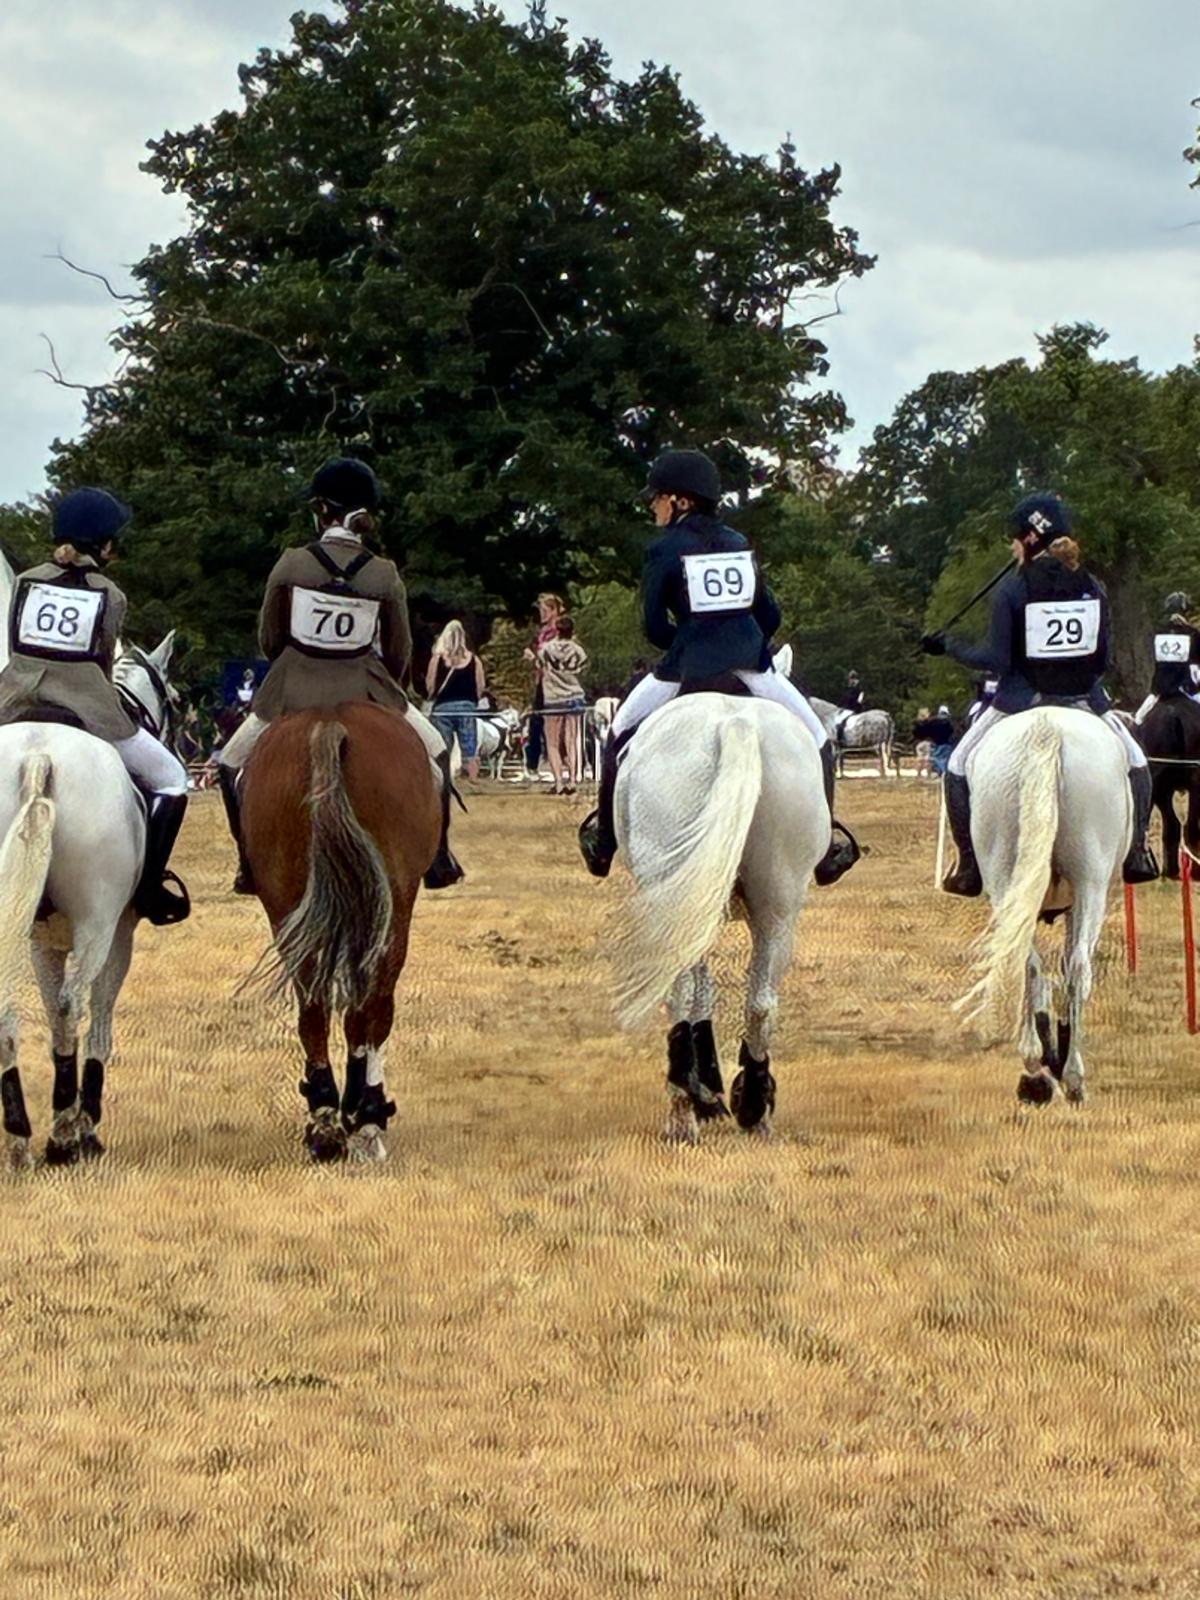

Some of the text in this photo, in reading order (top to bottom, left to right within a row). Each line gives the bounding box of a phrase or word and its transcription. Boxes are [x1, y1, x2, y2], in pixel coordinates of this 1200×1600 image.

[704, 567, 743, 597] 69
[37, 603, 79, 638] 68
[313, 609, 354, 637] 70
[1046, 618, 1083, 646] 29
[1160, 640, 1182, 656] 62
